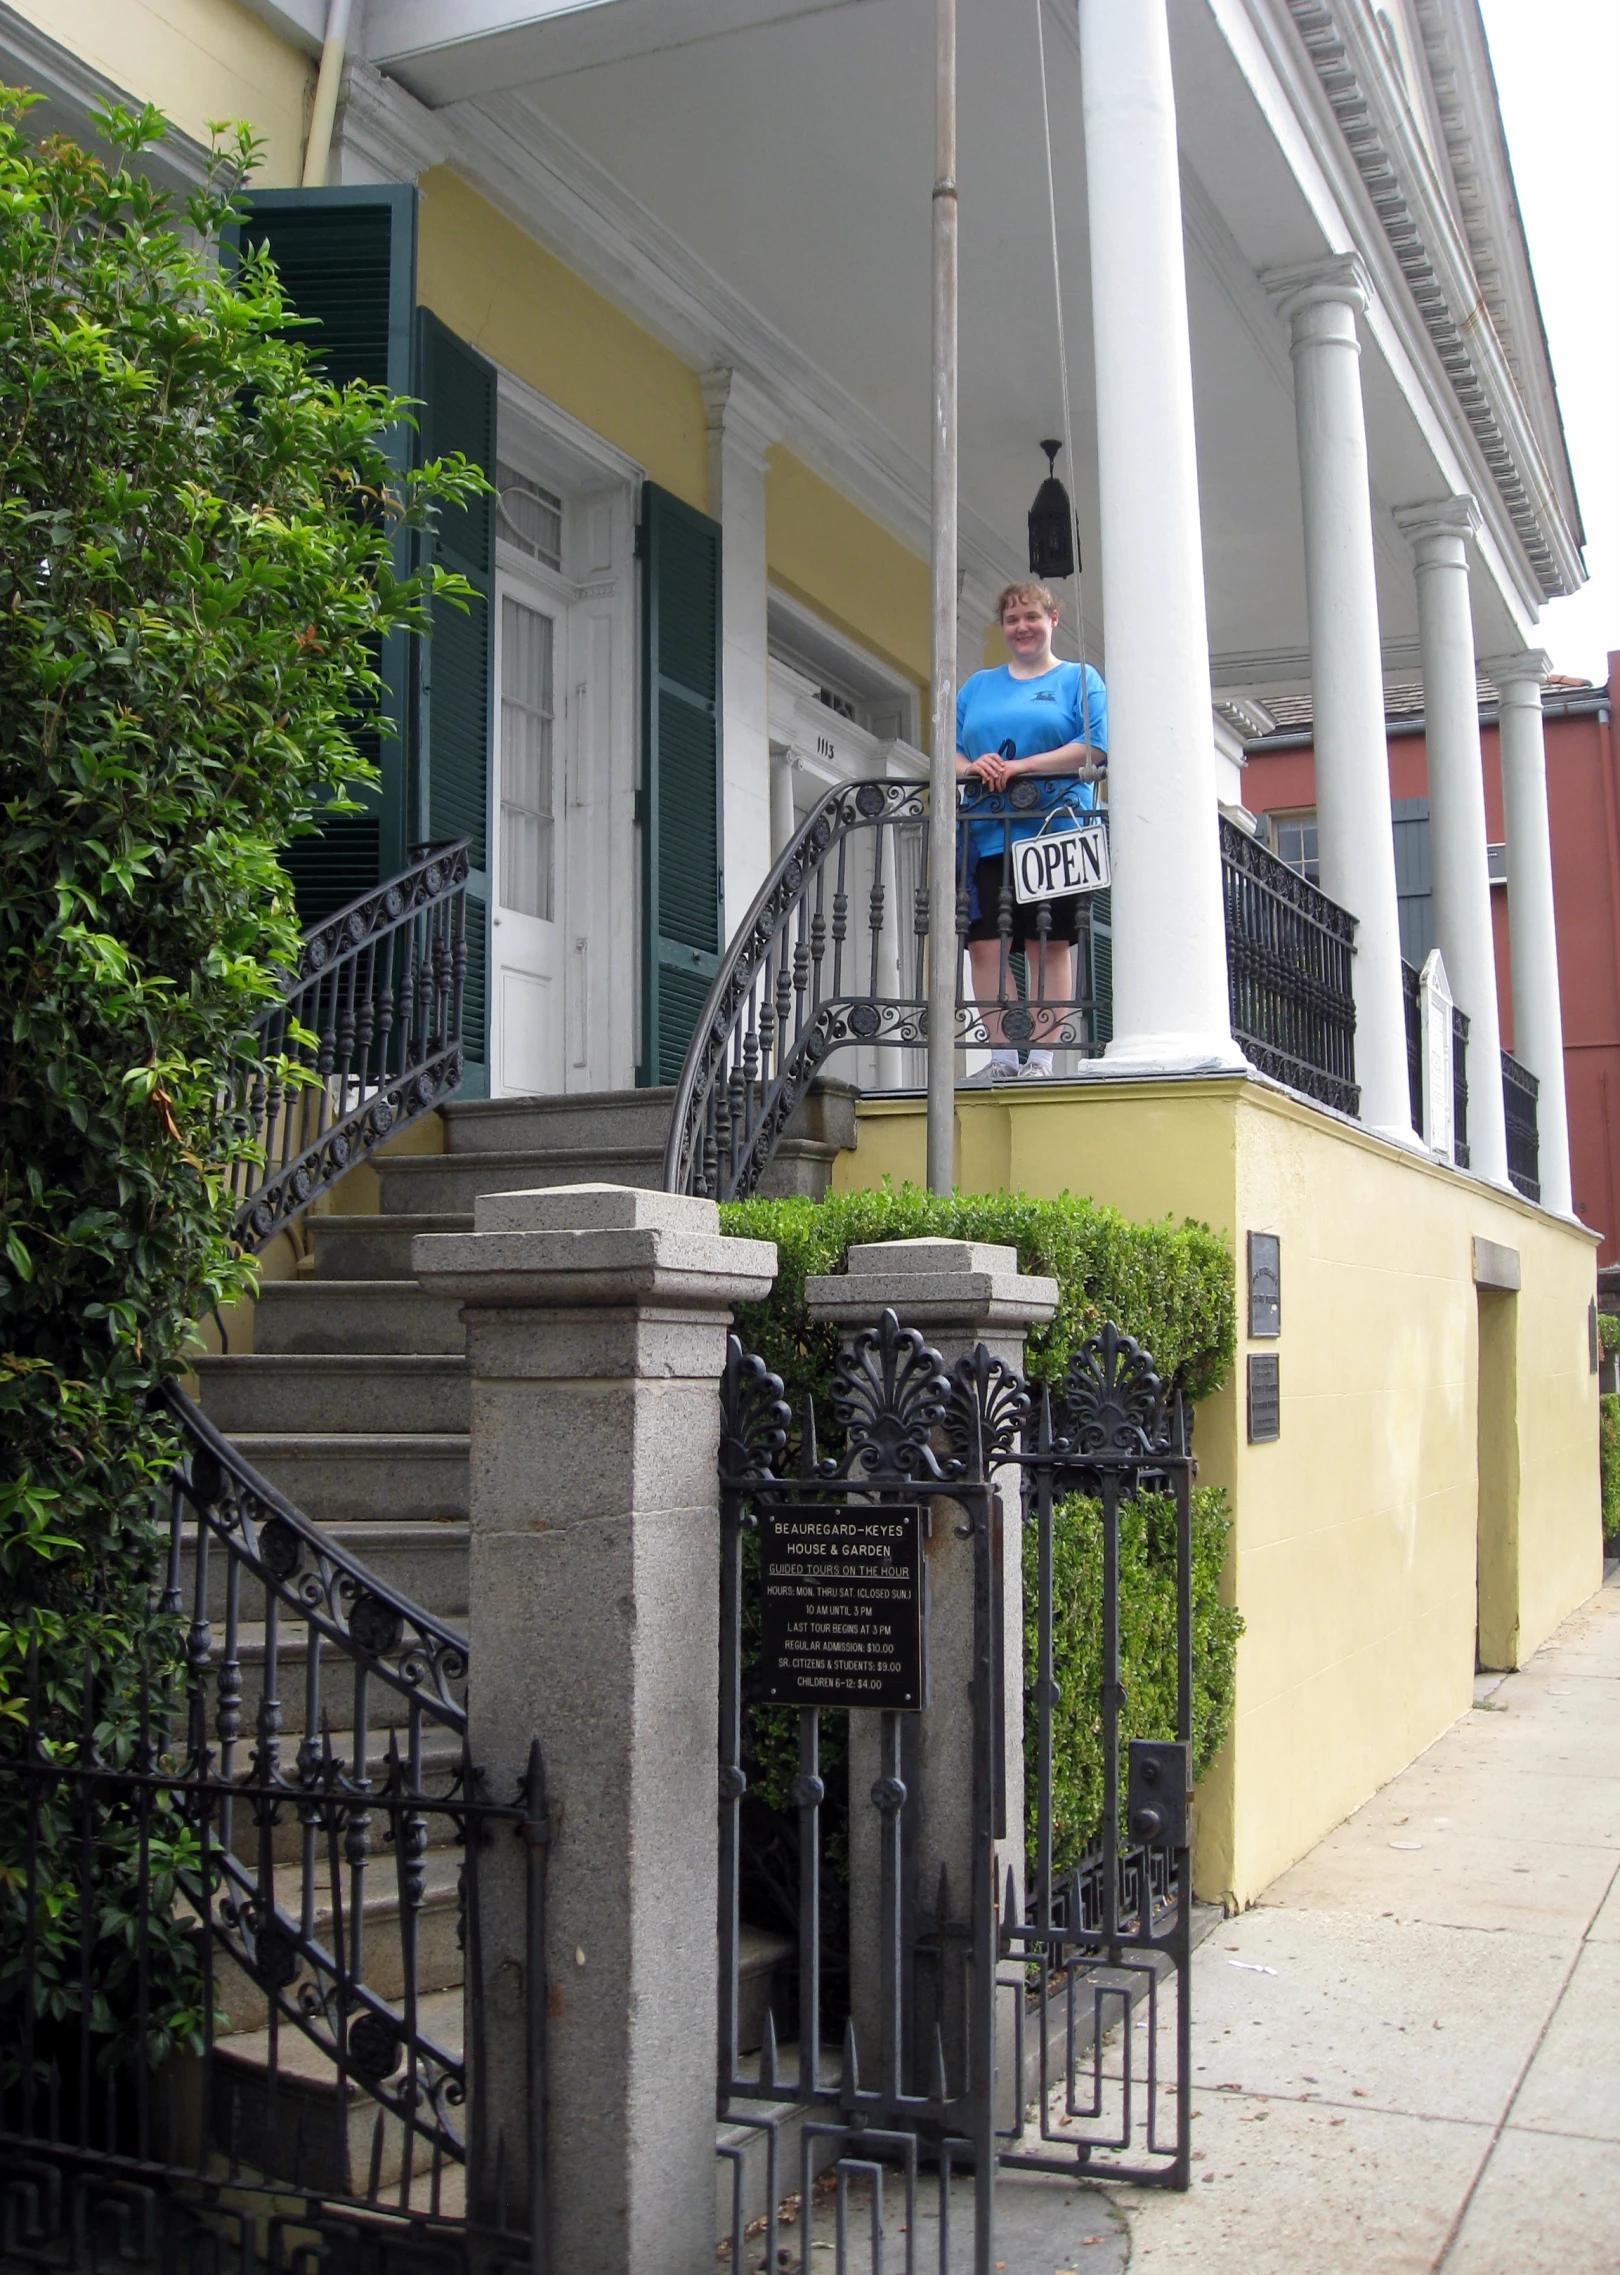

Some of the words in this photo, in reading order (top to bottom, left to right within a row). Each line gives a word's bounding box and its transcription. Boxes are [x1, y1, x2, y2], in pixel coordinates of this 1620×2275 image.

[817, 736, 834, 759] 1113
[1022, 833, 1100, 895] OPEN
[774, 1523, 903, 1536] BEAUREGARD-KEYES
[787, 1543, 827, 1555] HOUSE
[830, 1544, 838, 1556] &
[842, 1545, 891, 1556] GARDEN
[769, 1563, 803, 1574] GUIDED
[808, 1564, 840, 1575] TOURS
[842, 1565, 856, 1576] ON
[859, 1566, 878, 1577] THE
[881, 1567, 910, 1577] HOUR
[767, 1586, 795, 1596] HOURS:
[796, 1586, 815, 1597] MON.
[817, 1587, 838, 1598] THRU
[857, 1588, 890, 1599] (CLOSED
[891, 1589, 912, 1599] SUN.)
[806, 1604, 815, 1615] 10
[816, 1605, 828, 1615] AM
[829, 1605, 852, 1616] UNTIL
[853, 1606, 859, 1617] 3
[860, 1606, 873, 1617] PM
[787, 1622, 808, 1632] LAST
[811, 1622, 831, 1633] TOUR
[832, 1623, 859, 1634] BEGINS
[860, 1624, 871, 1635] AT
[872, 1625, 878, 1635] 3
[880, 1625, 892, 1636] PM
[784, 1640, 821, 1651] REGULAR
[822, 1641, 865, 1653] ADMISSION:
[867, 1643, 894, 1654] $10.00
[778, 1657, 791, 1668] SR.
[792, 1658, 825, 1670] CITIZENS
[826, 1660, 832, 1670] &
[834, 1660, 876, 1671] STUDENTS:
[877, 1661, 902, 1672] $9.00
[797, 1676, 834, 1688] CHILDREN
[835, 1678, 856, 1689] 6-12:
[857, 1679, 882, 1690] $4.00
